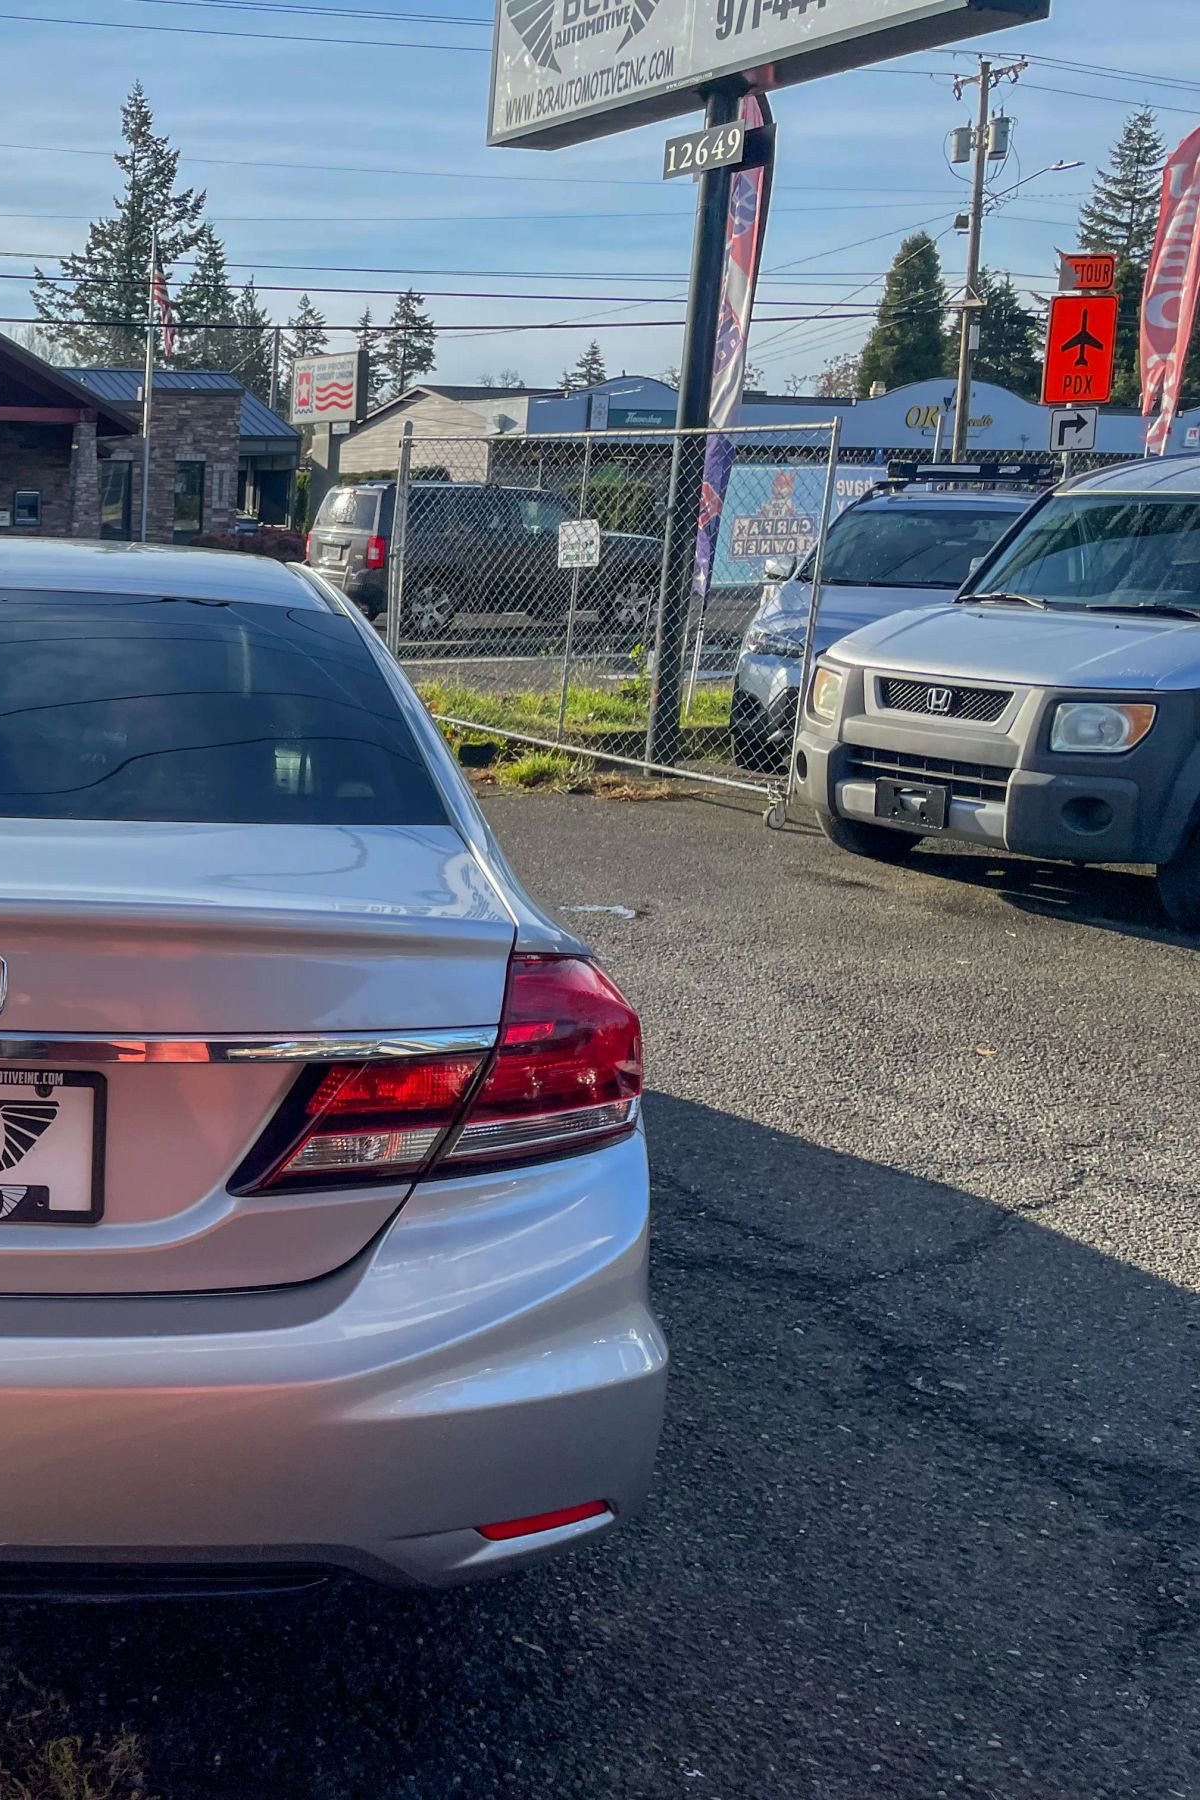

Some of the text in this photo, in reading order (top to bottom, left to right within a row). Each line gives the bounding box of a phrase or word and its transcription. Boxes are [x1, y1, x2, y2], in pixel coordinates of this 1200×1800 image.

[554, 5, 631, 50] AUTOMOTIVE
[715, 0, 826, 40] 971-
[504, 46, 675, 127] WWW.BCRAUTOMOTIVEINC.COM
[666, 128, 741, 172] 12649
[1074, 263, 1111, 283] ETOUR
[1062, 375, 1094, 395] PDX
